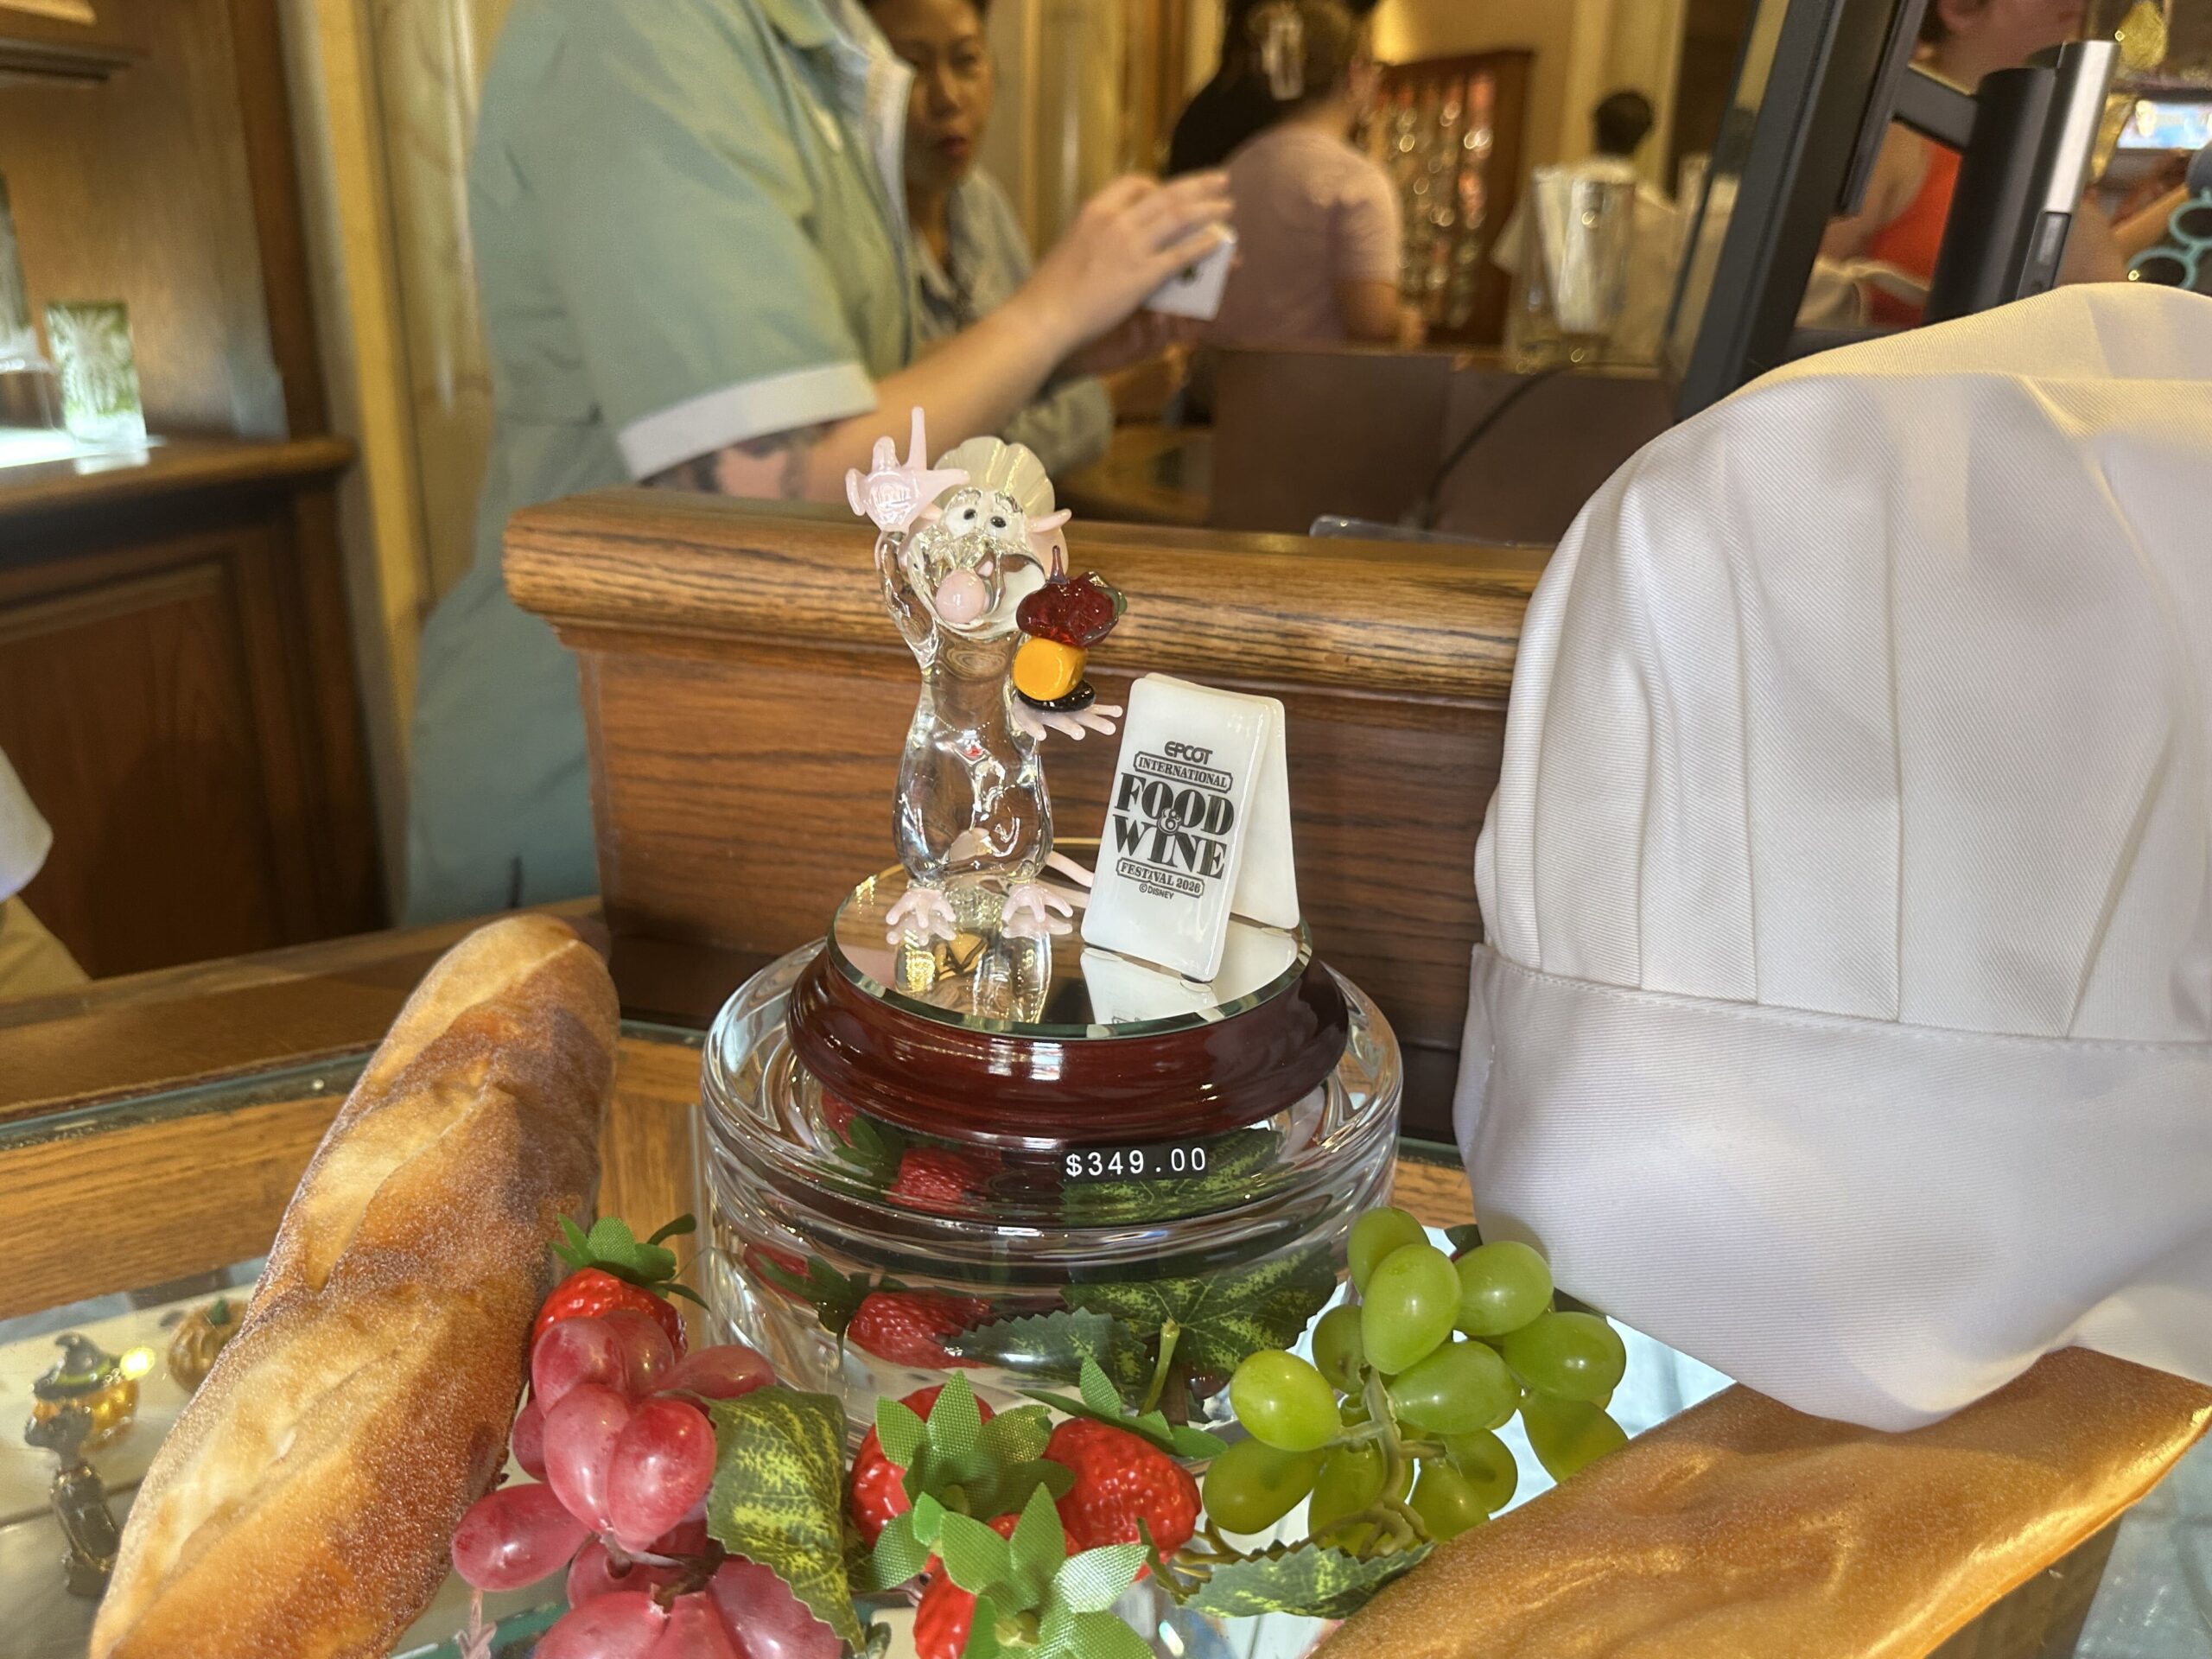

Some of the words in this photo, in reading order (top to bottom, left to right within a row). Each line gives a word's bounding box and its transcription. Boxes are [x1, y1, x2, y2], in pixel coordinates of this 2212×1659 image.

[1164, 741, 1213, 765] EPCOT
[1138, 756, 1228, 788] INTERNATIONAL
[1114, 772, 1235, 836] FOOD
[1157, 807, 1182, 836] &
[1112, 813, 1228, 880] WINE
[1120, 861, 1174, 887] FESTIVAL
[1065, 1147, 1206, 1178] $349.00
